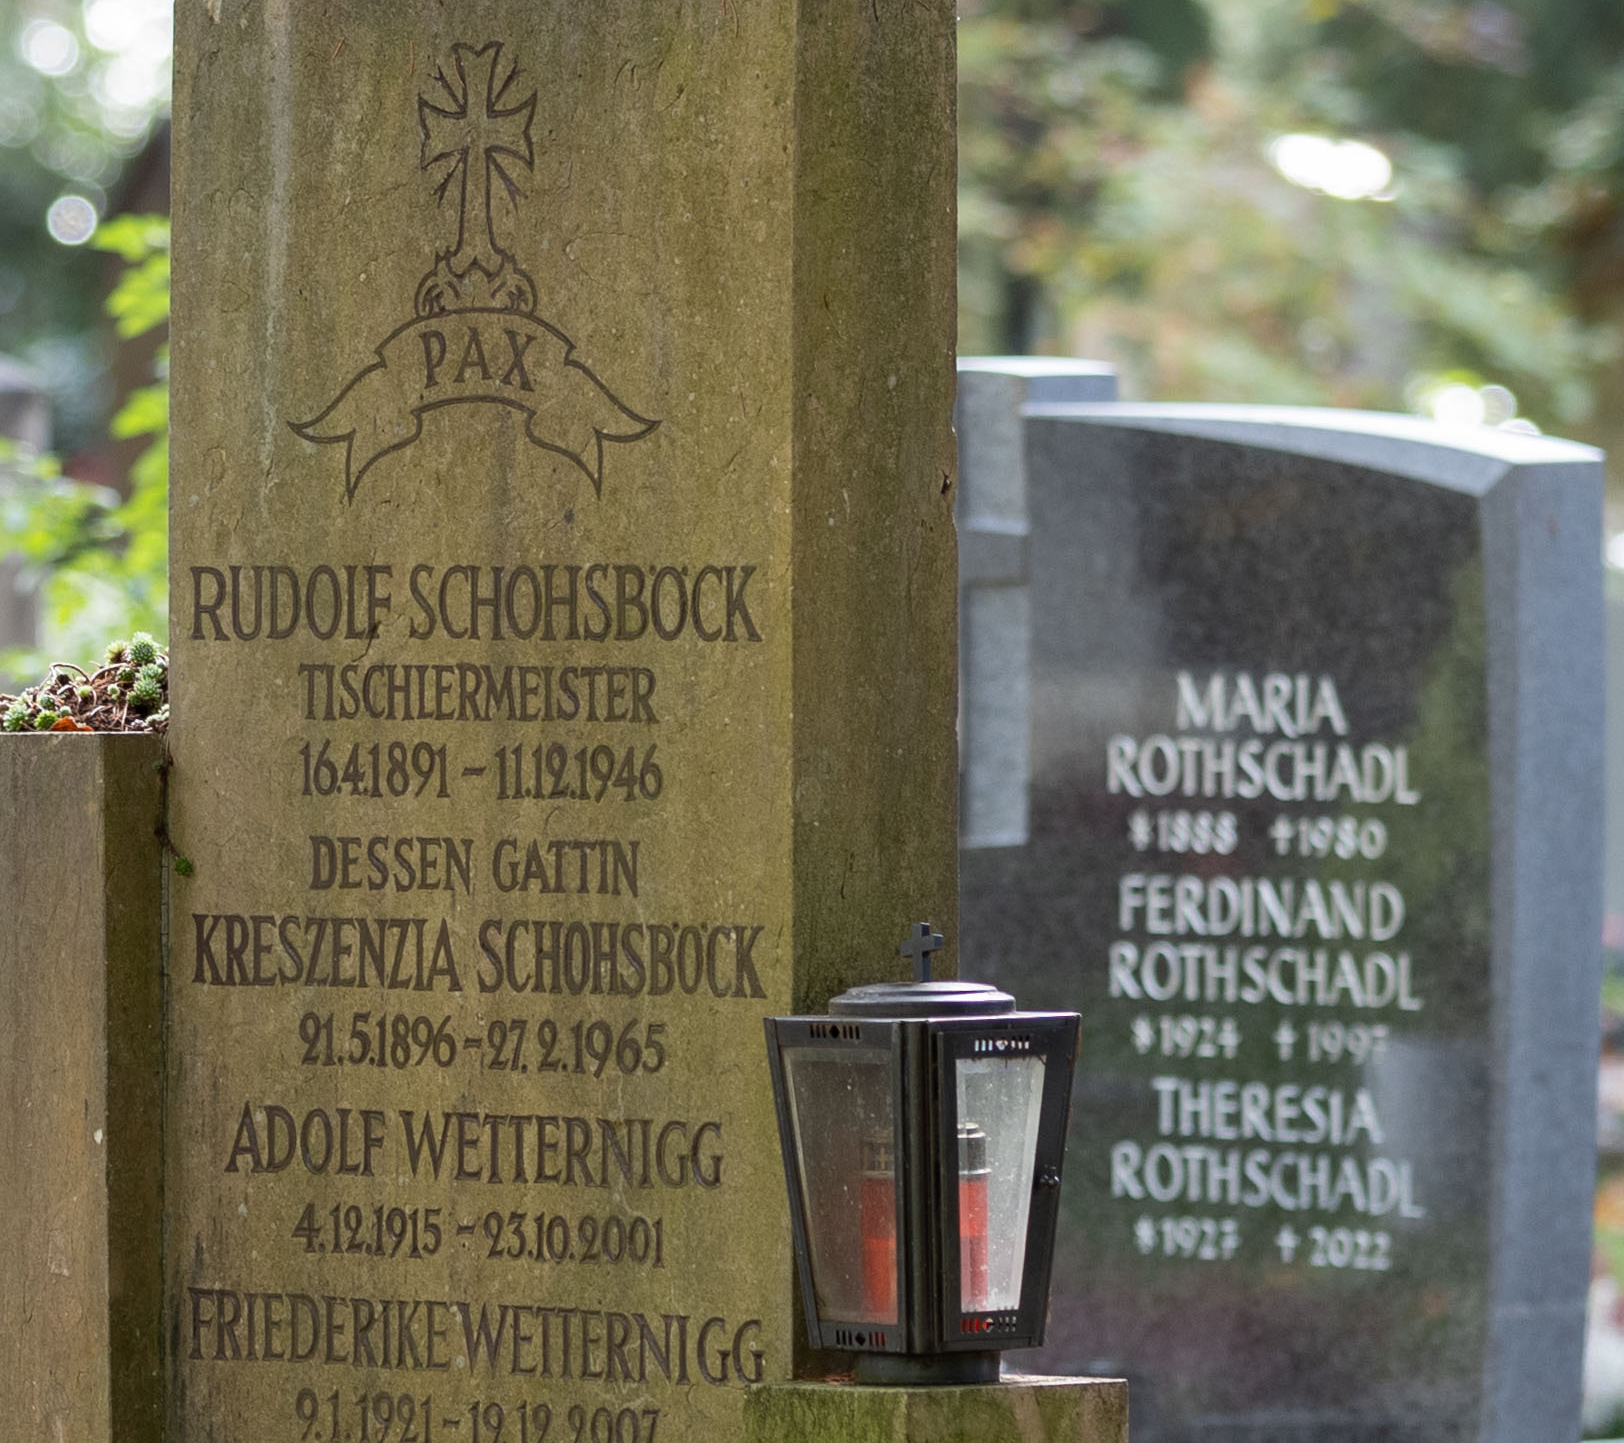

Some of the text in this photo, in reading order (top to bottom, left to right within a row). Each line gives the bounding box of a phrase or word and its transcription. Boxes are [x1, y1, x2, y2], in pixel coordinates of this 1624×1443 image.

[419, 328, 537, 392] PAX
[190, 564, 763, 643] RUDOLF SCHOHSBÖCK
[298, 662, 660, 724] TISCHLERMEISTER
[1176, 669, 1349, 738] MARIA
[493, 743, 663, 803] 11.12.1946
[1106, 733, 1422, 805] ROTHSCHADL
[308, 834, 641, 898] DESSEN GATTIN
[1118, 873, 1405, 941] FERDINAND
[191, 914, 768, 999] KRESZENZIA SCHOHSBÖCK
[1108, 940, 1425, 1011] ROTHSCHADL
[298, 1011, 456, 1069] 21.5.1896
[1151, 1075, 1386, 1146] THERESIA
[224, 1101, 724, 1191] ADOLF WETTERNIGG
[1109, 1139, 1427, 1219] ROTHSCHADL
[291, 1201, 444, 1259] 4.12.1915
[482, 1210, 664, 1270] 23.10.2001
[1308, 1225, 1393, 1271] 2022
[188, 1286, 766, 1387] FRIEDERIKE WETTERNIGG
